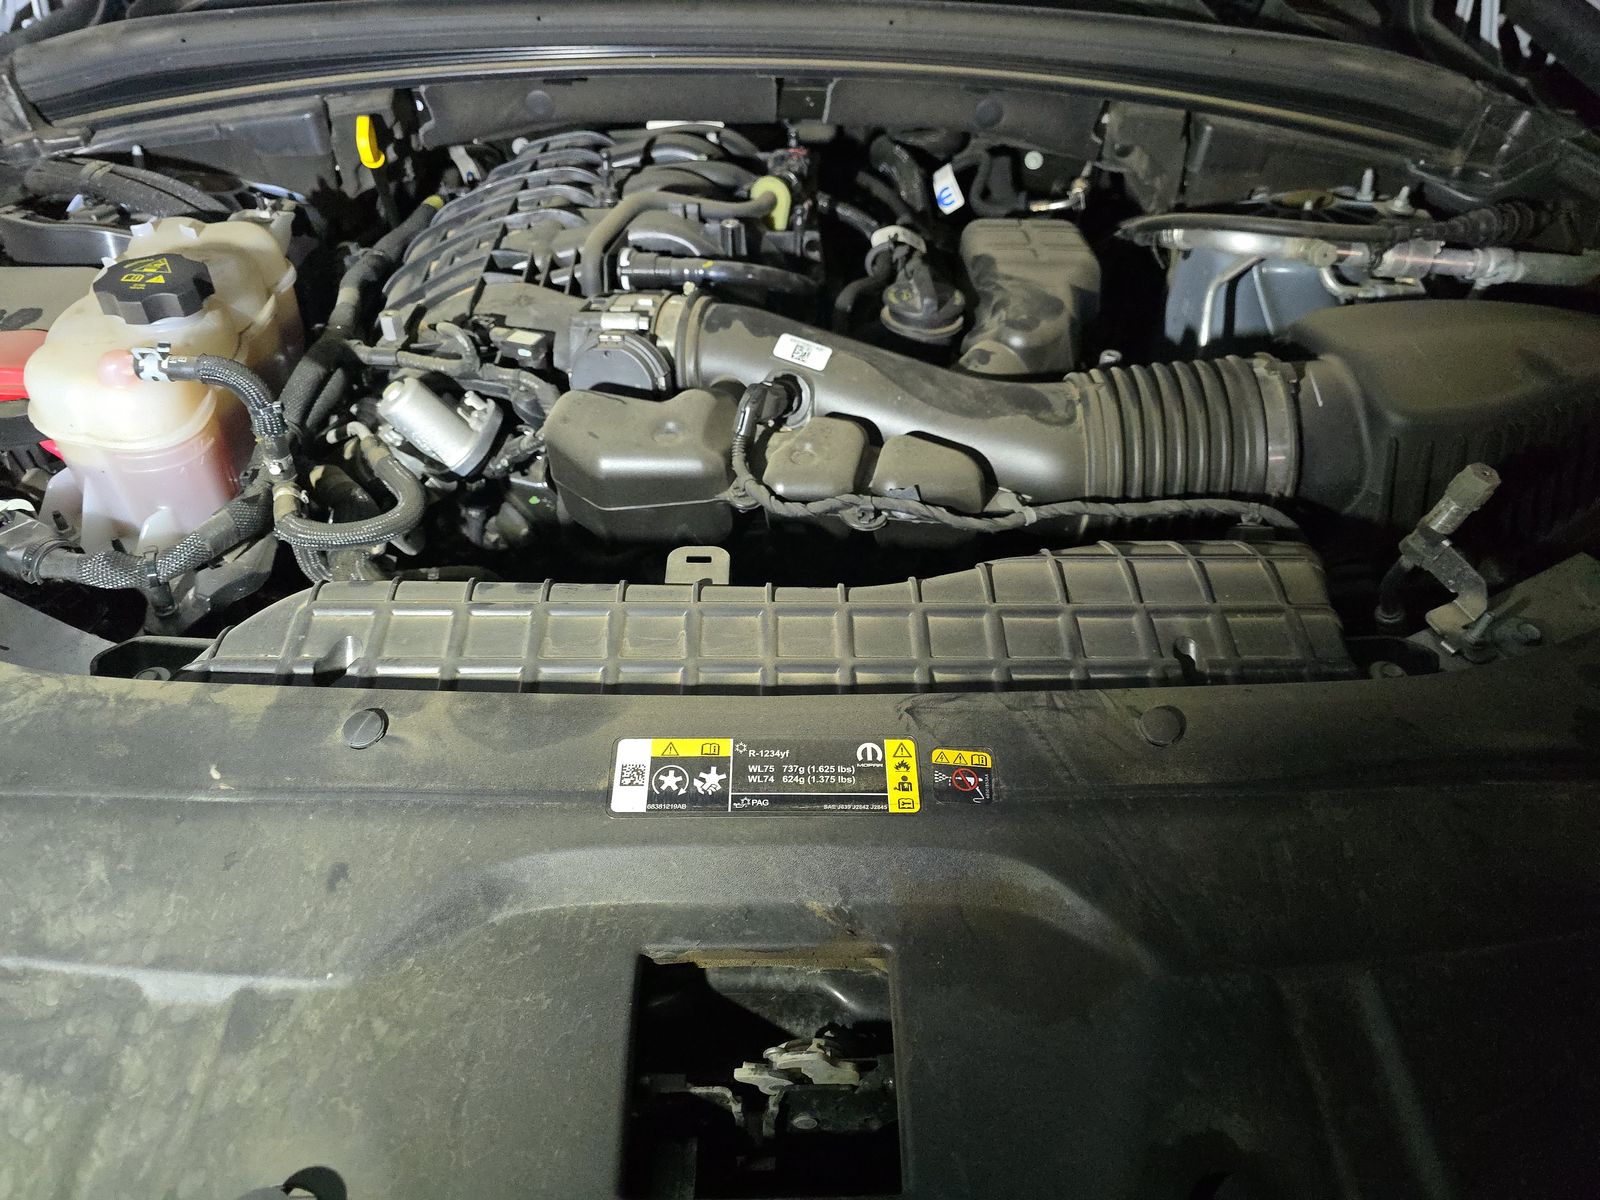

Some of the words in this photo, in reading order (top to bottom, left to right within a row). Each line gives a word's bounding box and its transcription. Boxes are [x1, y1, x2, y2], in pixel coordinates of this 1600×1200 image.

[748, 750, 790, 759] R-1234yf
[748, 765, 775, 773] WL75
[782, 765, 805, 774] 737g
[807, 765, 836, 774] (1.625
[838, 765, 856, 774] lbs)
[748, 775, 775, 783] WL74
[782, 775, 805, 784] 624g
[807, 775, 836, 784] (1.375
[838, 775, 856, 784] lbs)
